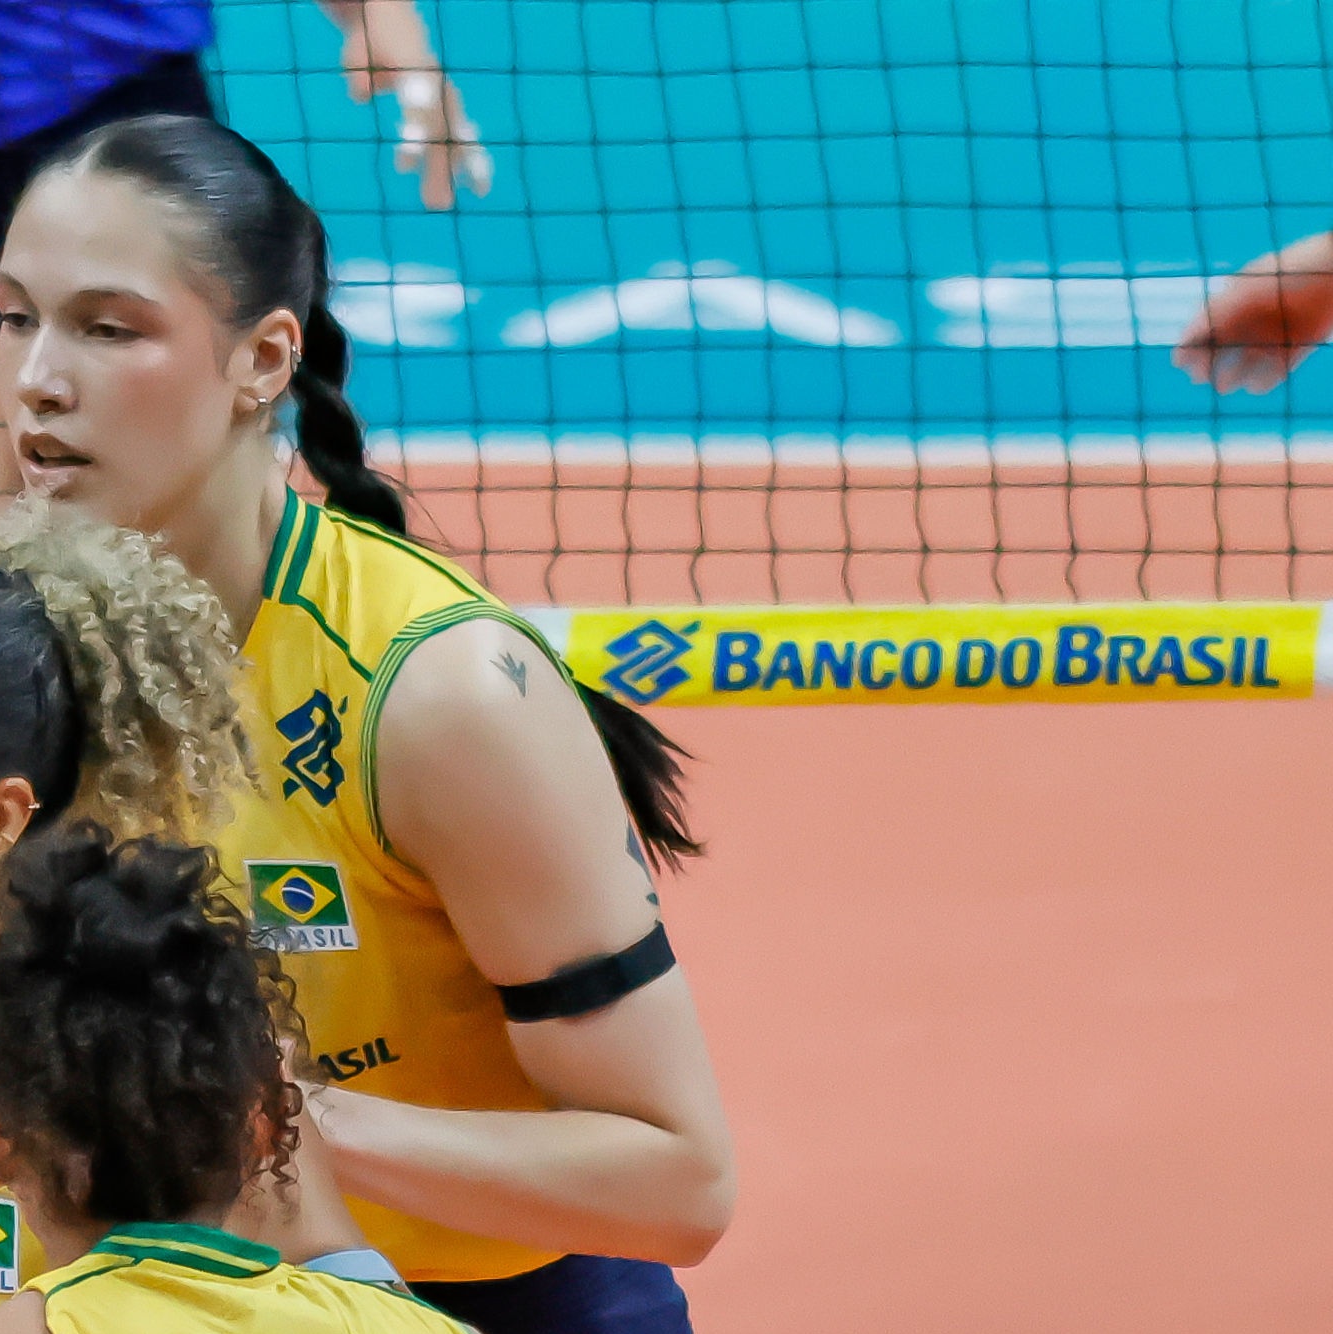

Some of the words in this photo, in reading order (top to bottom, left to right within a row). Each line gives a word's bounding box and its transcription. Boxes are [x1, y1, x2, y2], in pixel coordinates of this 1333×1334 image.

[712, 631, 943, 692] BANCO
[954, 637, 1042, 689] DO
[1053, 625, 1280, 688] BRASIL
